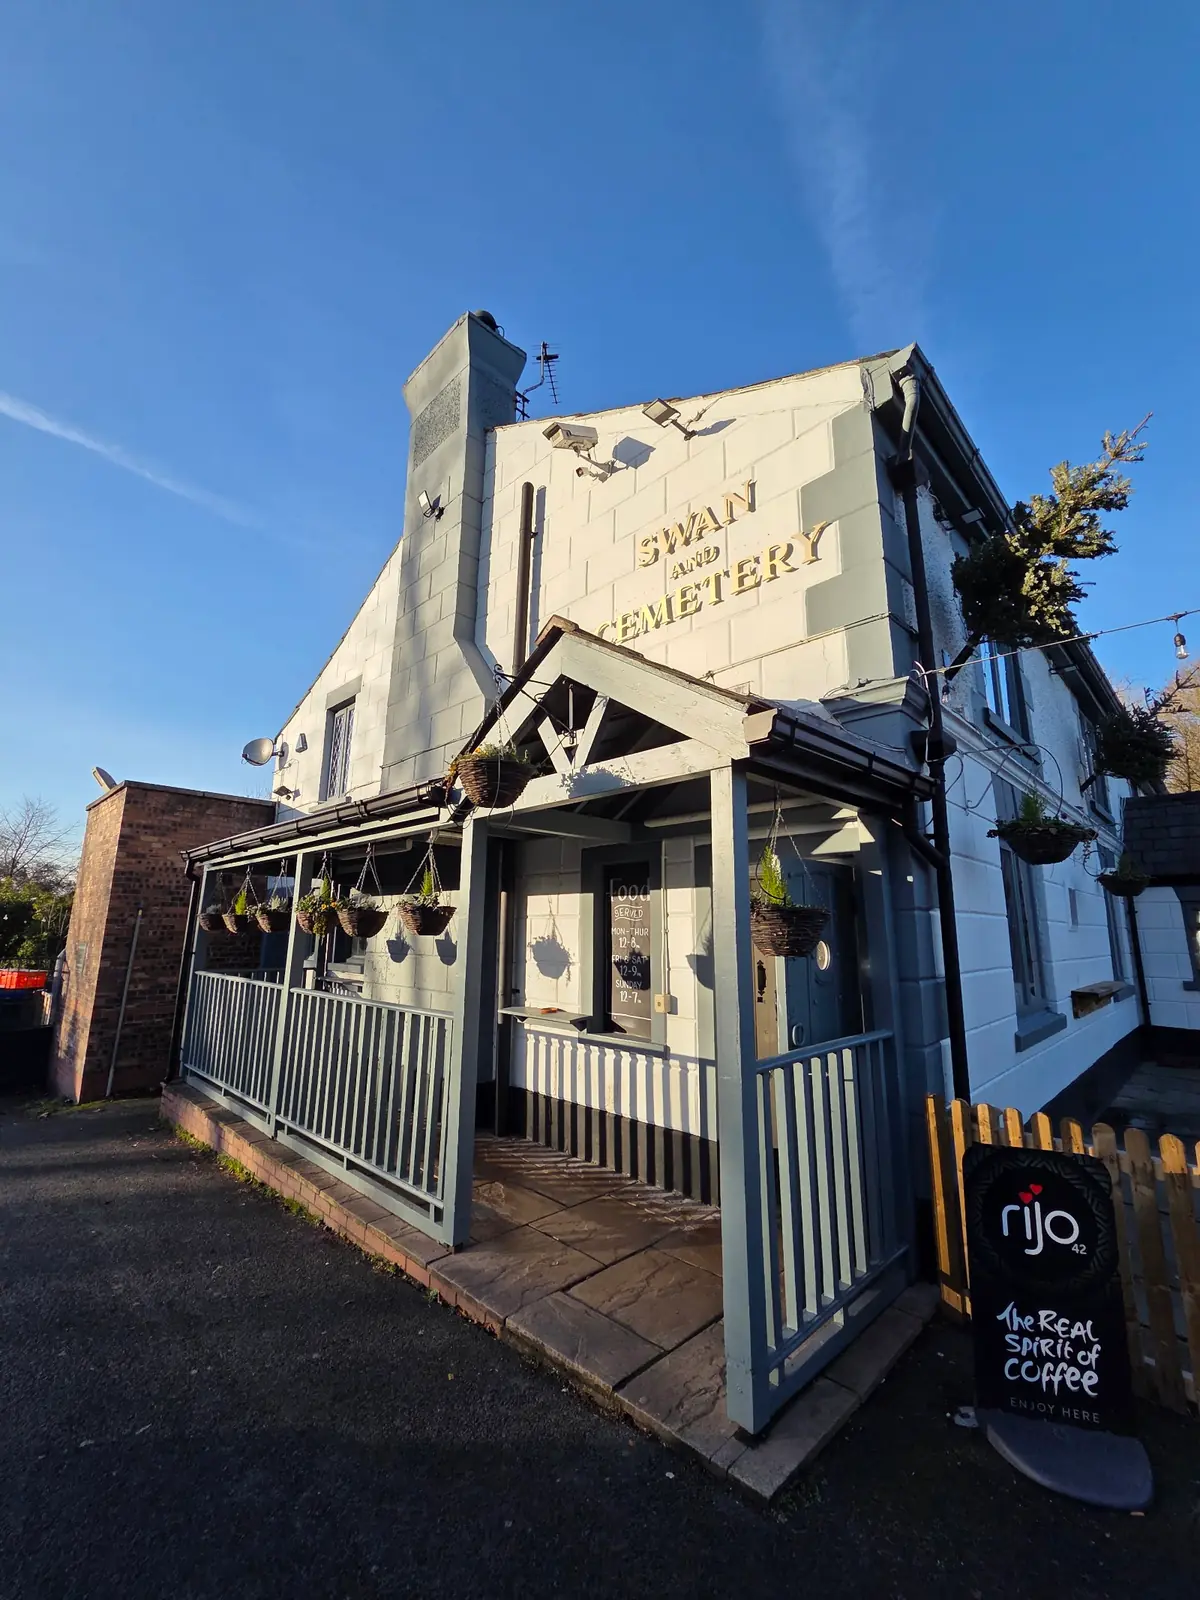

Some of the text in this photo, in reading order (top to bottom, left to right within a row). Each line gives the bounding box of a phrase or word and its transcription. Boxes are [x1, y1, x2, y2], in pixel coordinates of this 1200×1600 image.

[639, 478, 757, 567] SWAN
[670, 545, 720, 579] AND
[611, 954, 622, 963] FRI
[1071, 1243, 1087, 1255] 42
[996, 1300, 1035, 1332] The
[1076, 1343, 1102, 1370] of
[1009, 1396, 1101, 1425] ENJOY HERE
